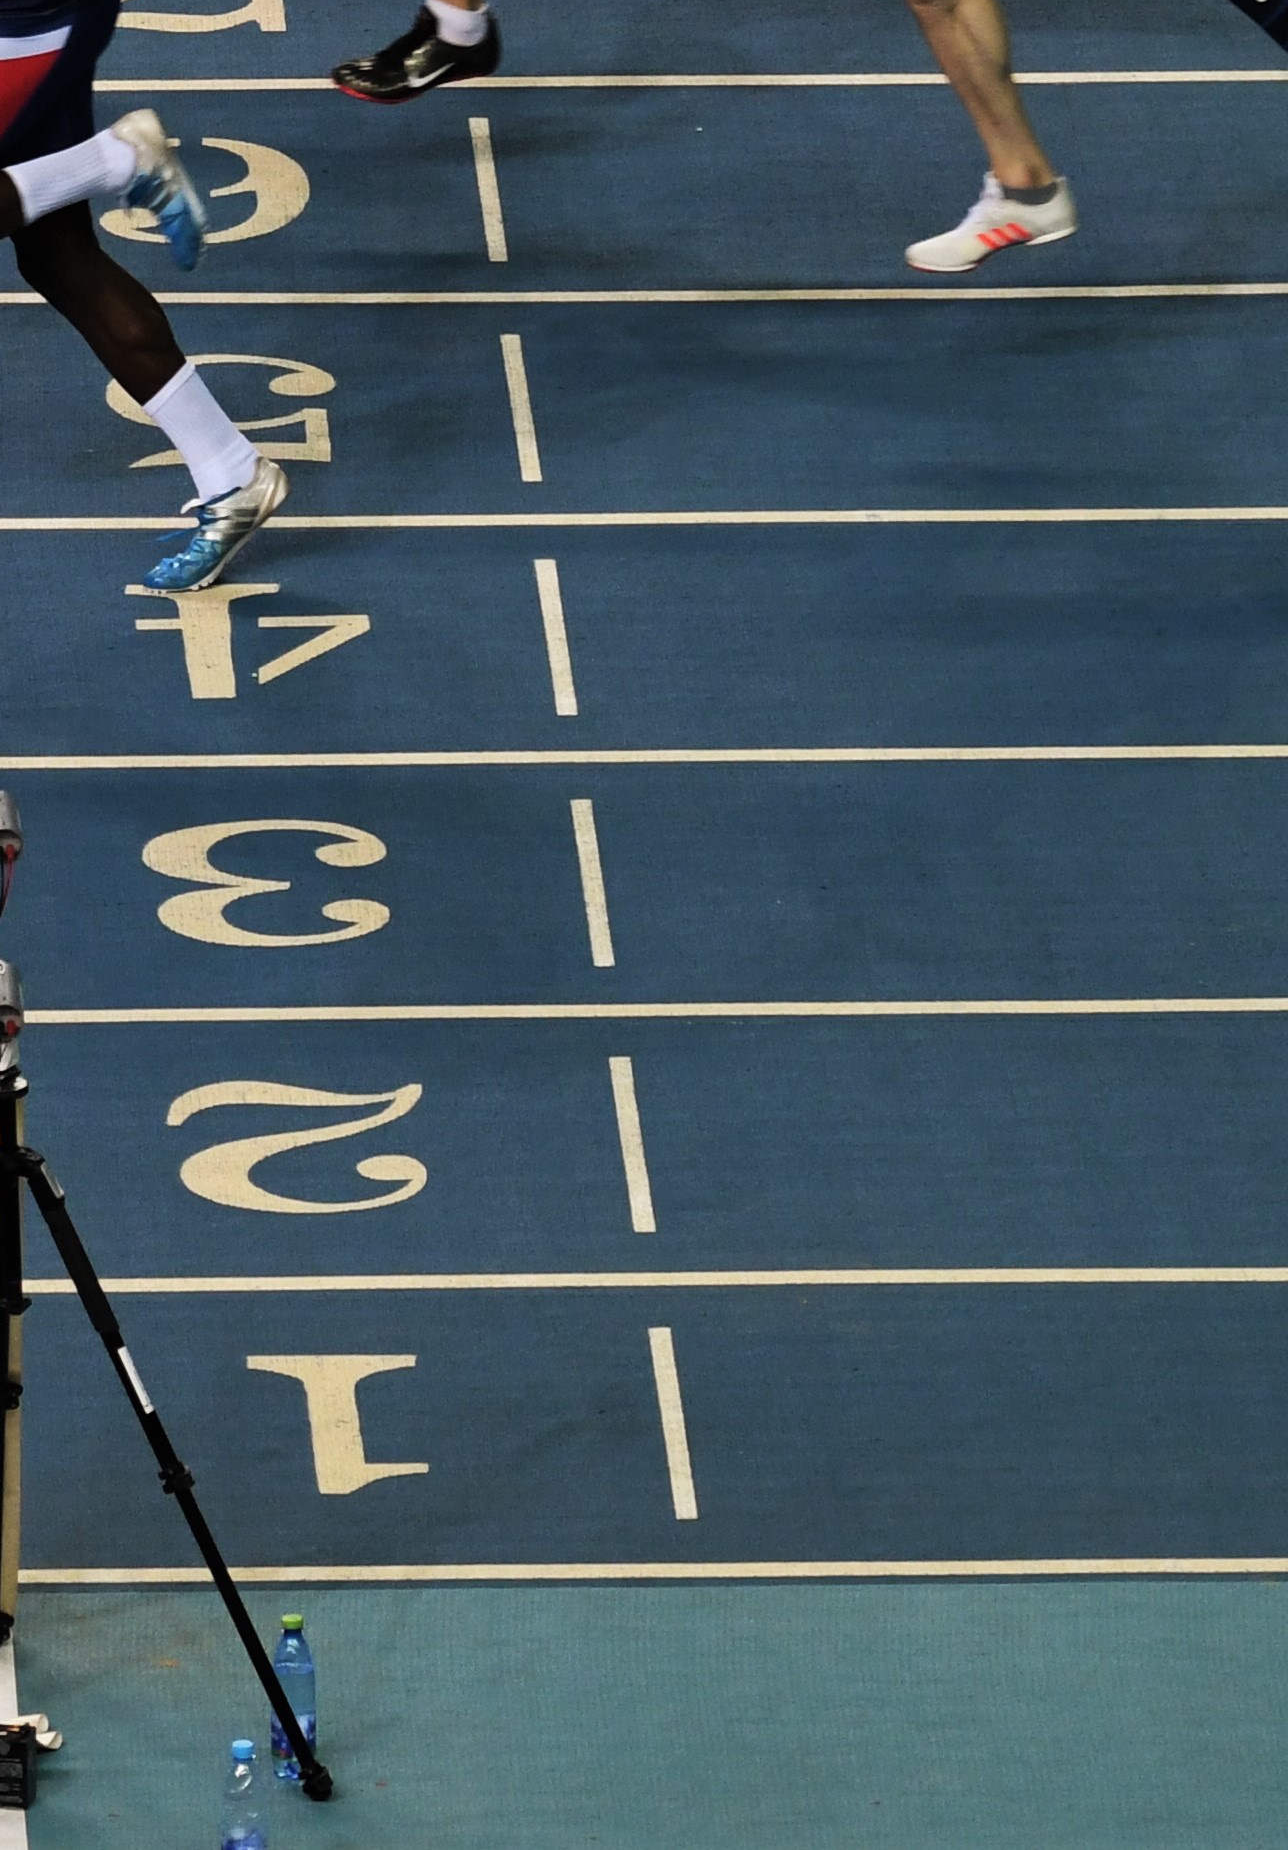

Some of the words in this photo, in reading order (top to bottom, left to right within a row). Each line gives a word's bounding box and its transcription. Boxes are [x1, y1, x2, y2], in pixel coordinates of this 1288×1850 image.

[123, 582, 371, 700] 4
[141, 818, 391, 947] 3
[165, 1079, 428, 1215] 2
[246, 1354, 430, 1495] 1
